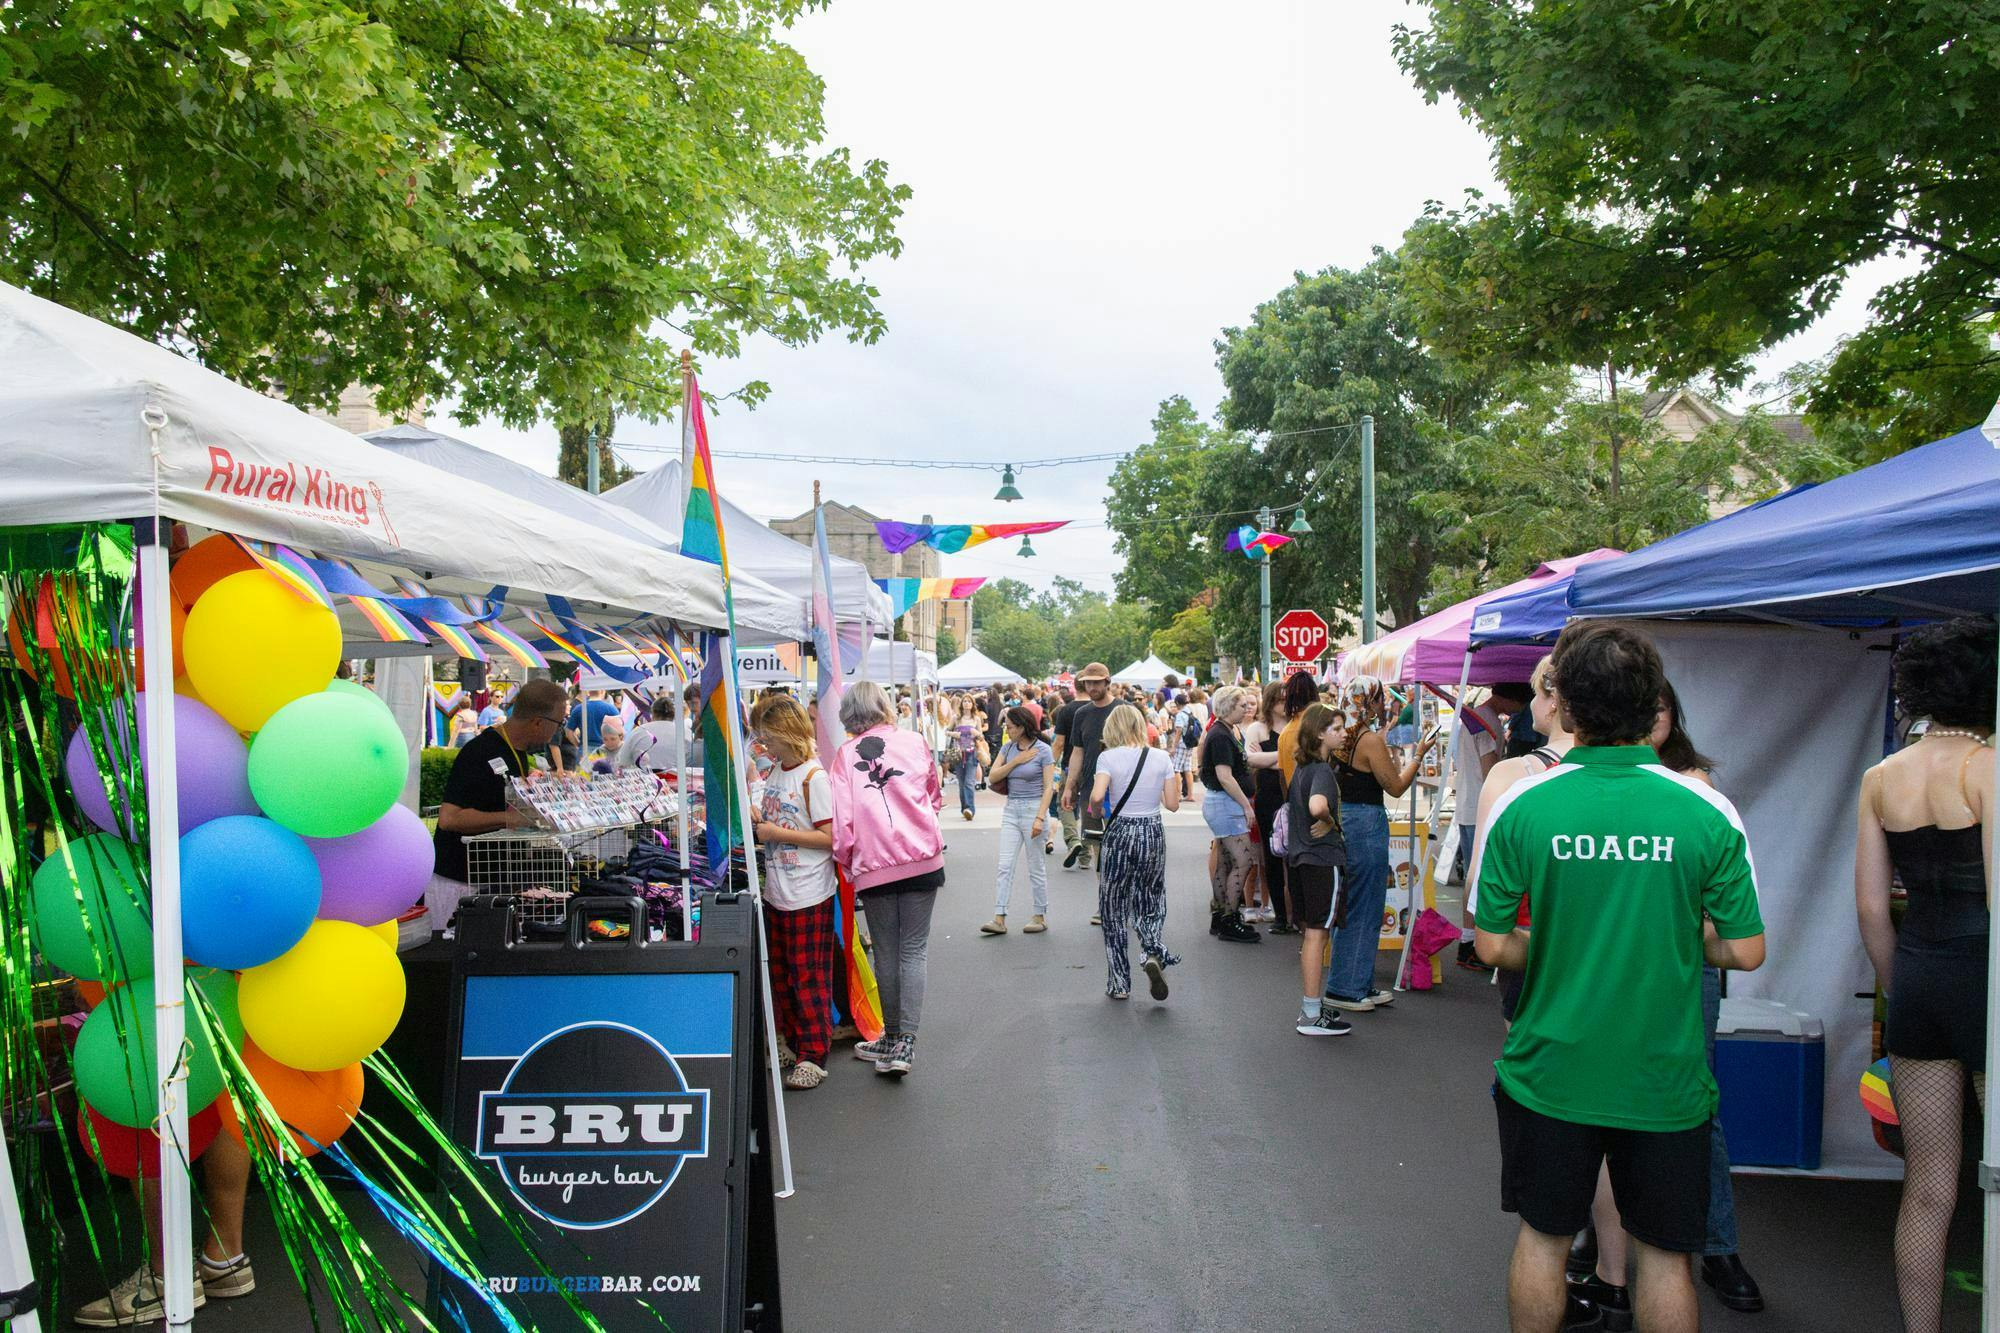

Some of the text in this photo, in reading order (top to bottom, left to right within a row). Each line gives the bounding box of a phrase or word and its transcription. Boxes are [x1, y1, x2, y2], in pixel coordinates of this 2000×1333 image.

[205, 446, 369, 525] Rural King
[1278, 627, 1324, 647] STOP
[1551, 834, 1675, 862] COACH
[494, 1104, 693, 1144] BRU
[519, 1164, 662, 1203] burger bar
